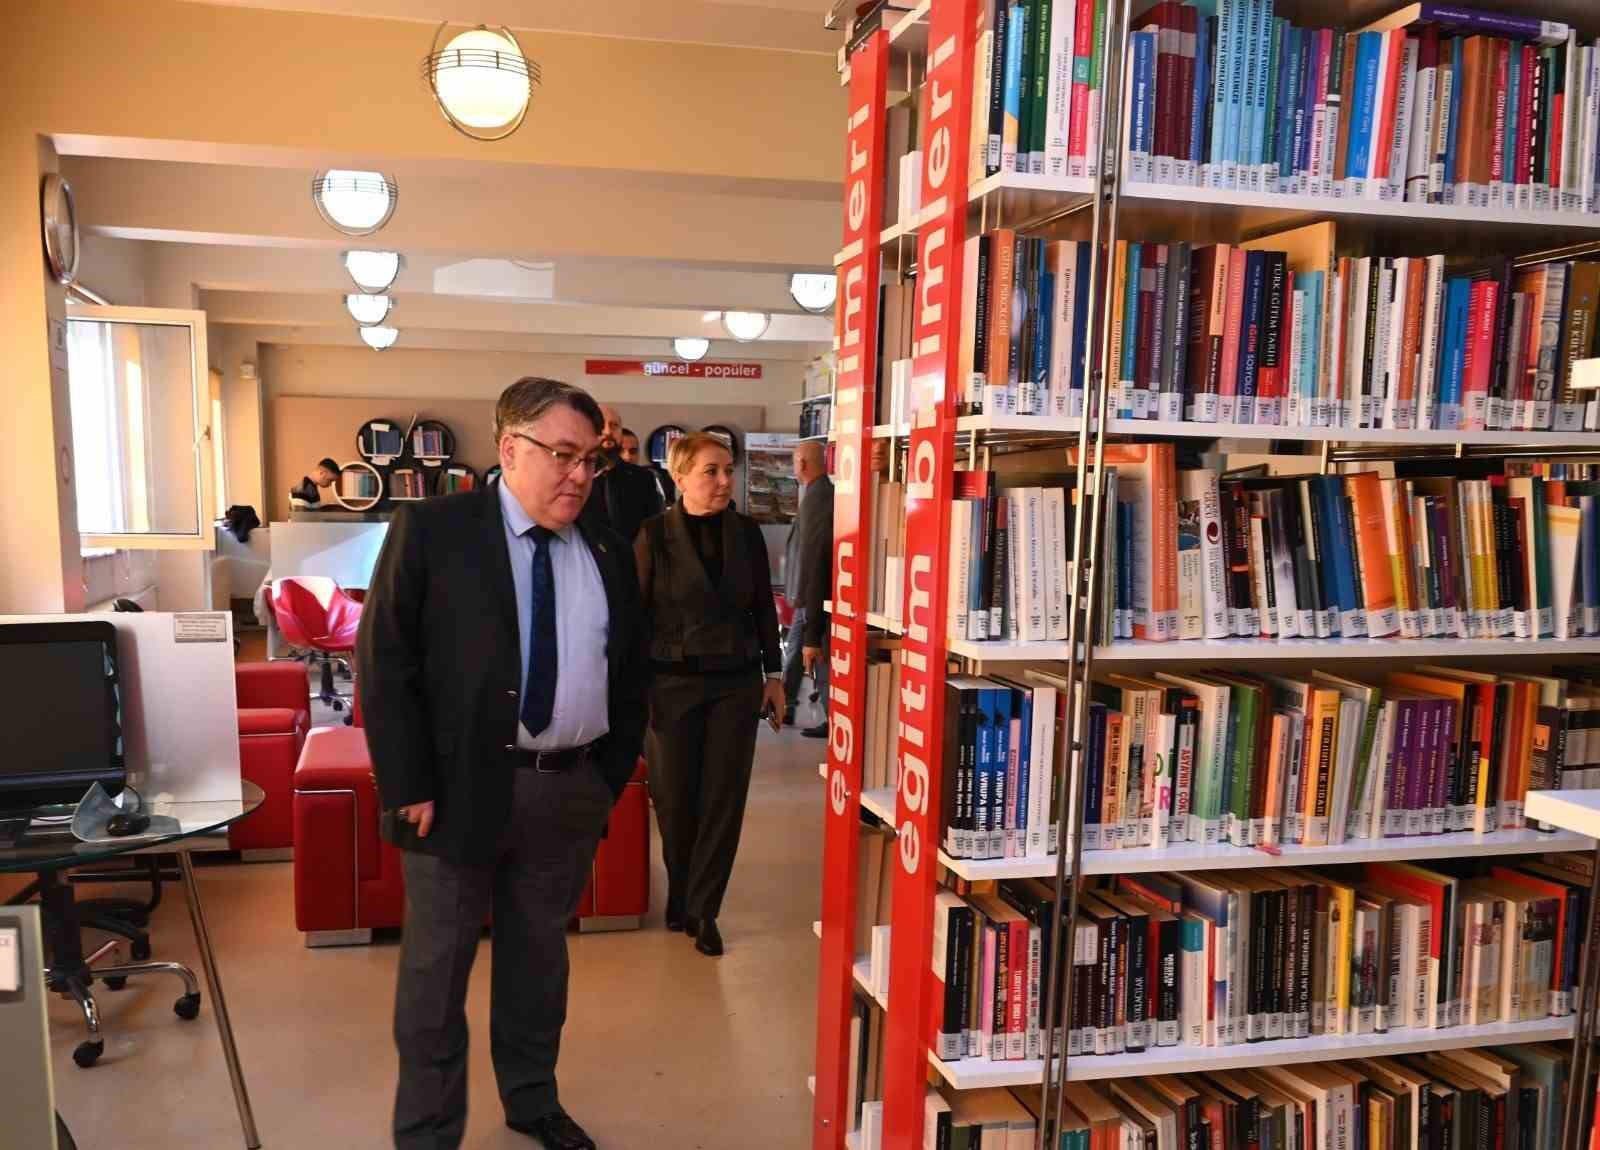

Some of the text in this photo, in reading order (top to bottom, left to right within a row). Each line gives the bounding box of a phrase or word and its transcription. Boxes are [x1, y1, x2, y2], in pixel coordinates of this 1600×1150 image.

[1272, 263, 1282, 289] TÜRK
[1270, 292, 1280, 328] EĞİTİM
[643, 361, 689, 376] güncel
[704, 363, 757, 378] popüler
[828, 104, 870, 816] eğitim bilimleri
[897, 35, 956, 874] eğitim bilimleri
[979, 771, 988, 805] AVRUPA
[995, 771, 1004, 804] AVRUPA
